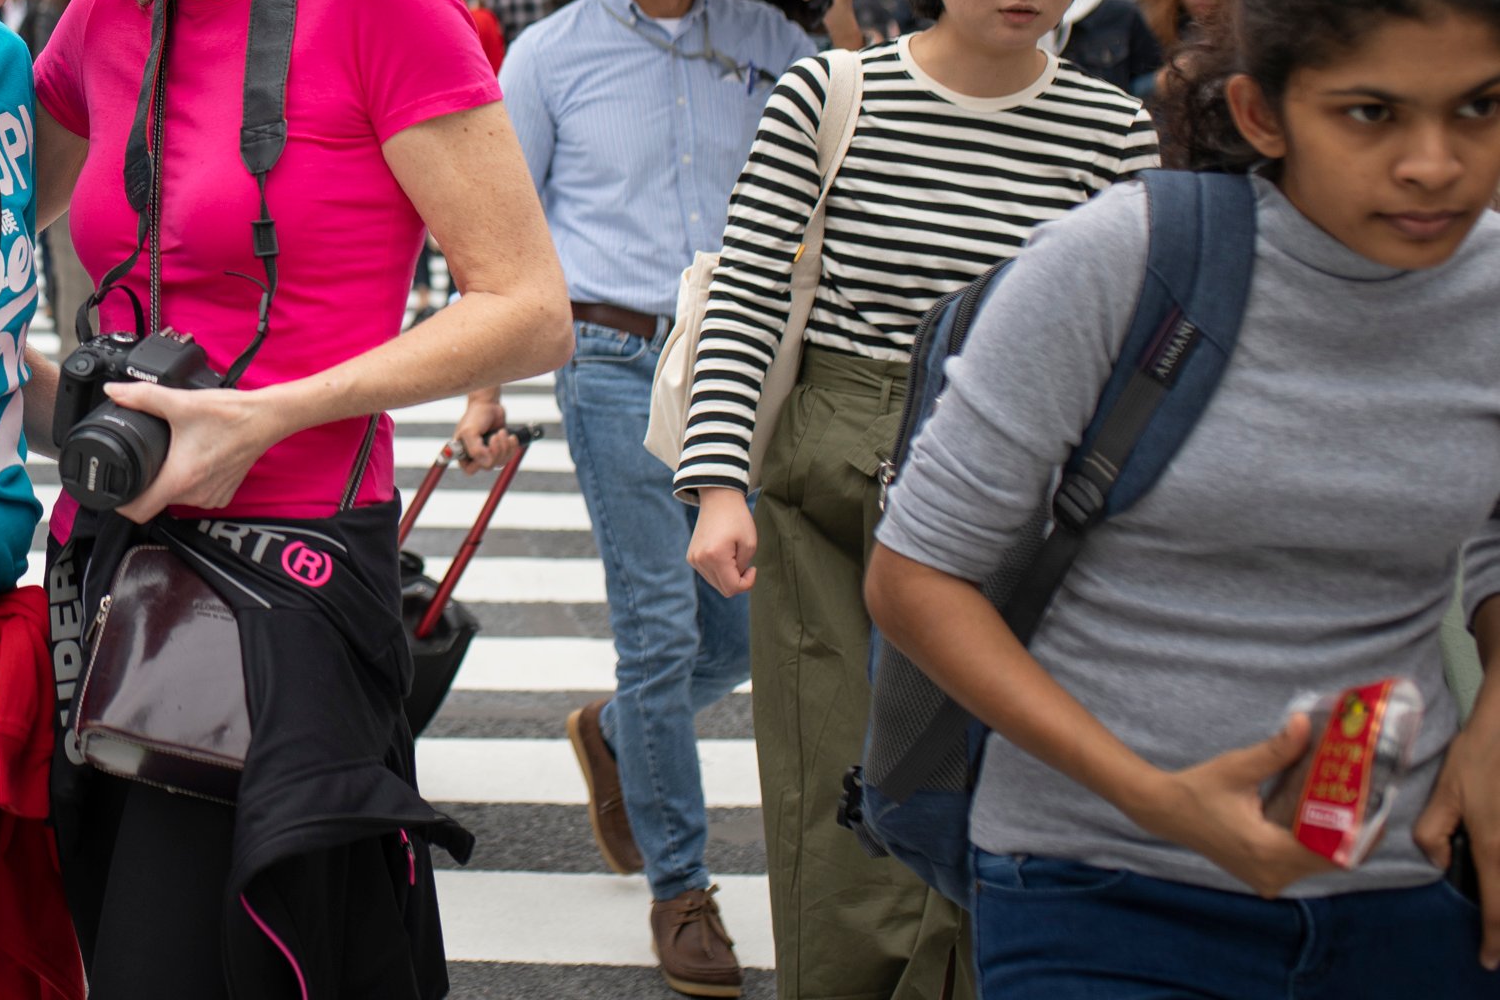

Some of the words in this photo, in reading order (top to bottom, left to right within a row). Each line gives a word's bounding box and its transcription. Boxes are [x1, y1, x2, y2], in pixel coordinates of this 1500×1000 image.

[1155, 320, 1197, 379] ARMANI
[126, 366, 158, 383] Canon
[87, 456, 100, 492] Canon
[198, 519, 286, 564] RT
